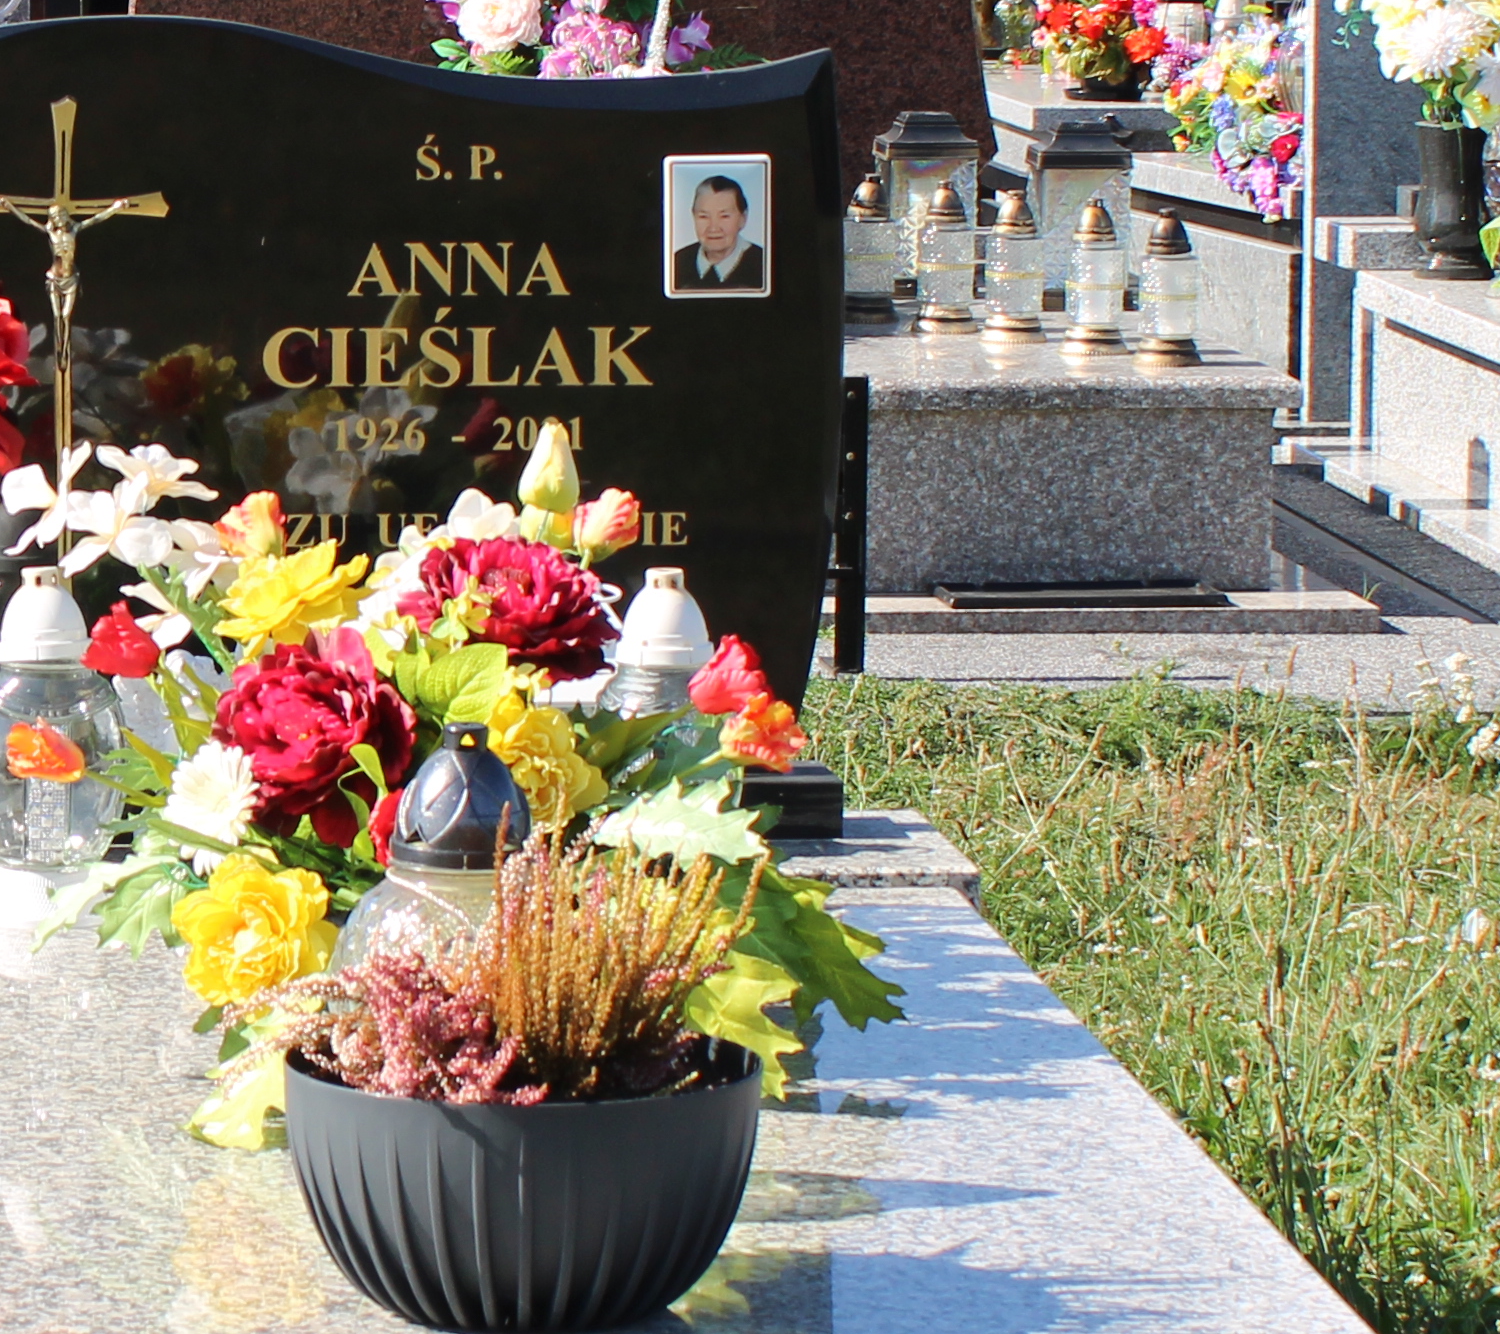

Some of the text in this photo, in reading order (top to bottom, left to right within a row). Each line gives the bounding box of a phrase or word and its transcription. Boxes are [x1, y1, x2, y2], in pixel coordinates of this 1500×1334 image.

[348, 242, 571, 296] ANNA
[262, 307, 653, 387] CIEŚLAK
[334, 417, 426, 451] 1926
[492, 417, 583, 451] 201
